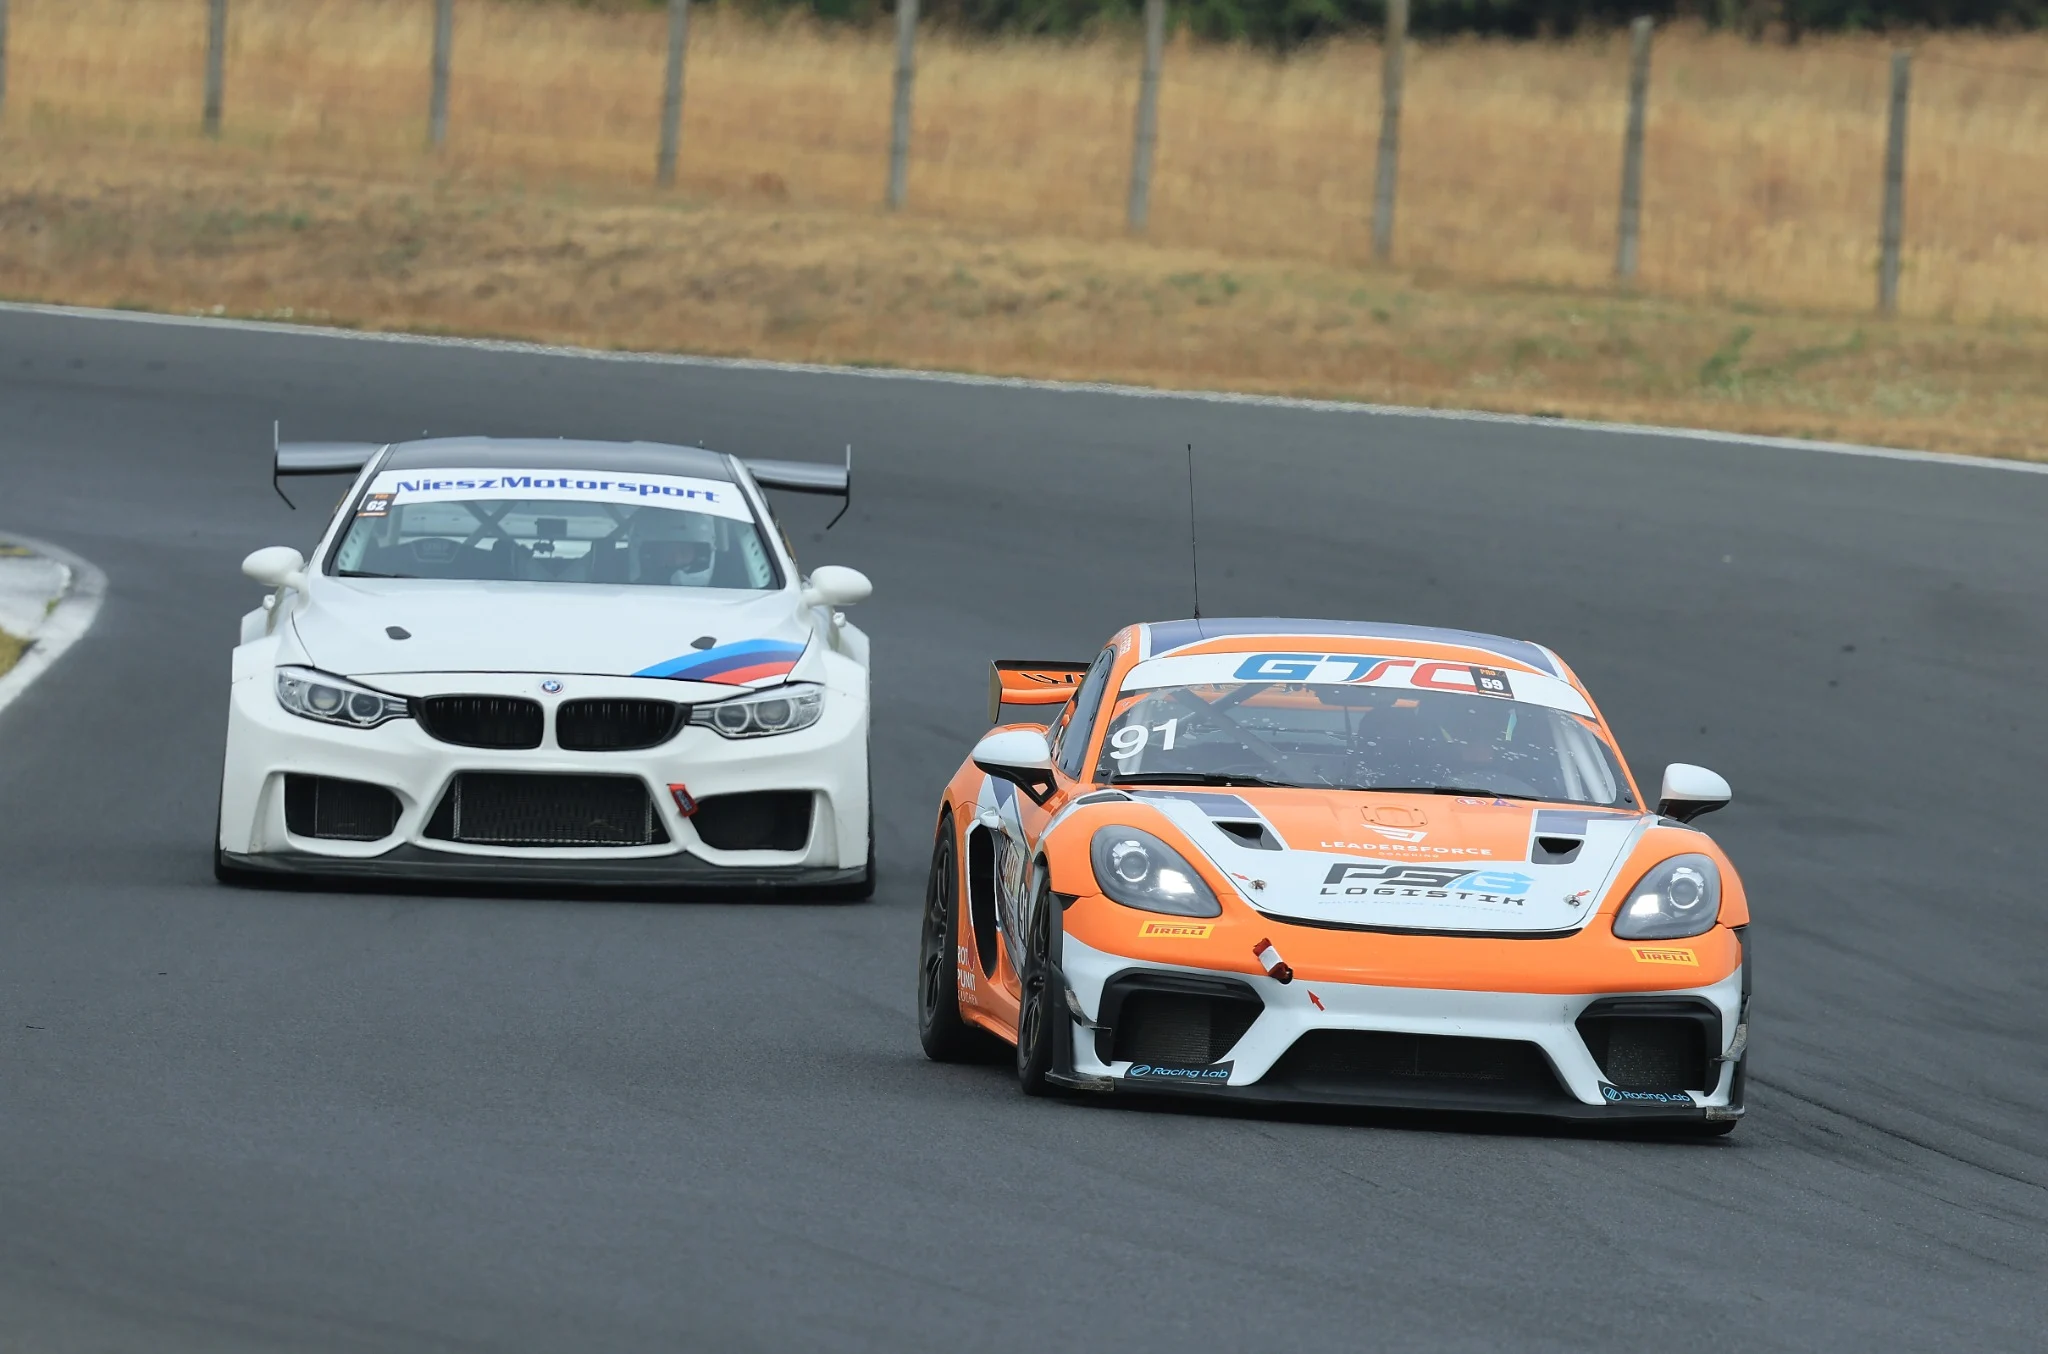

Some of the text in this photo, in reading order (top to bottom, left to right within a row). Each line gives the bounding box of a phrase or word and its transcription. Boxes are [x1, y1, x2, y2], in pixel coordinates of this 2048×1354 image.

[366, 500, 388, 511] 62
[1232, 653, 1479, 693] GTC
[1480, 677, 1504, 691] 59
[1110, 718, 1178, 760] 91
[1320, 841, 1492, 856] LEADERSFORCE
[1320, 887, 1526, 906] LOGISTIK
[1145, 924, 1207, 936] PIRELLI
[1636, 949, 1693, 962] PIRELLI
[1152, 1067, 1229, 1078] Racing Lab
[1621, 1090, 1691, 1102] Racing Lab
